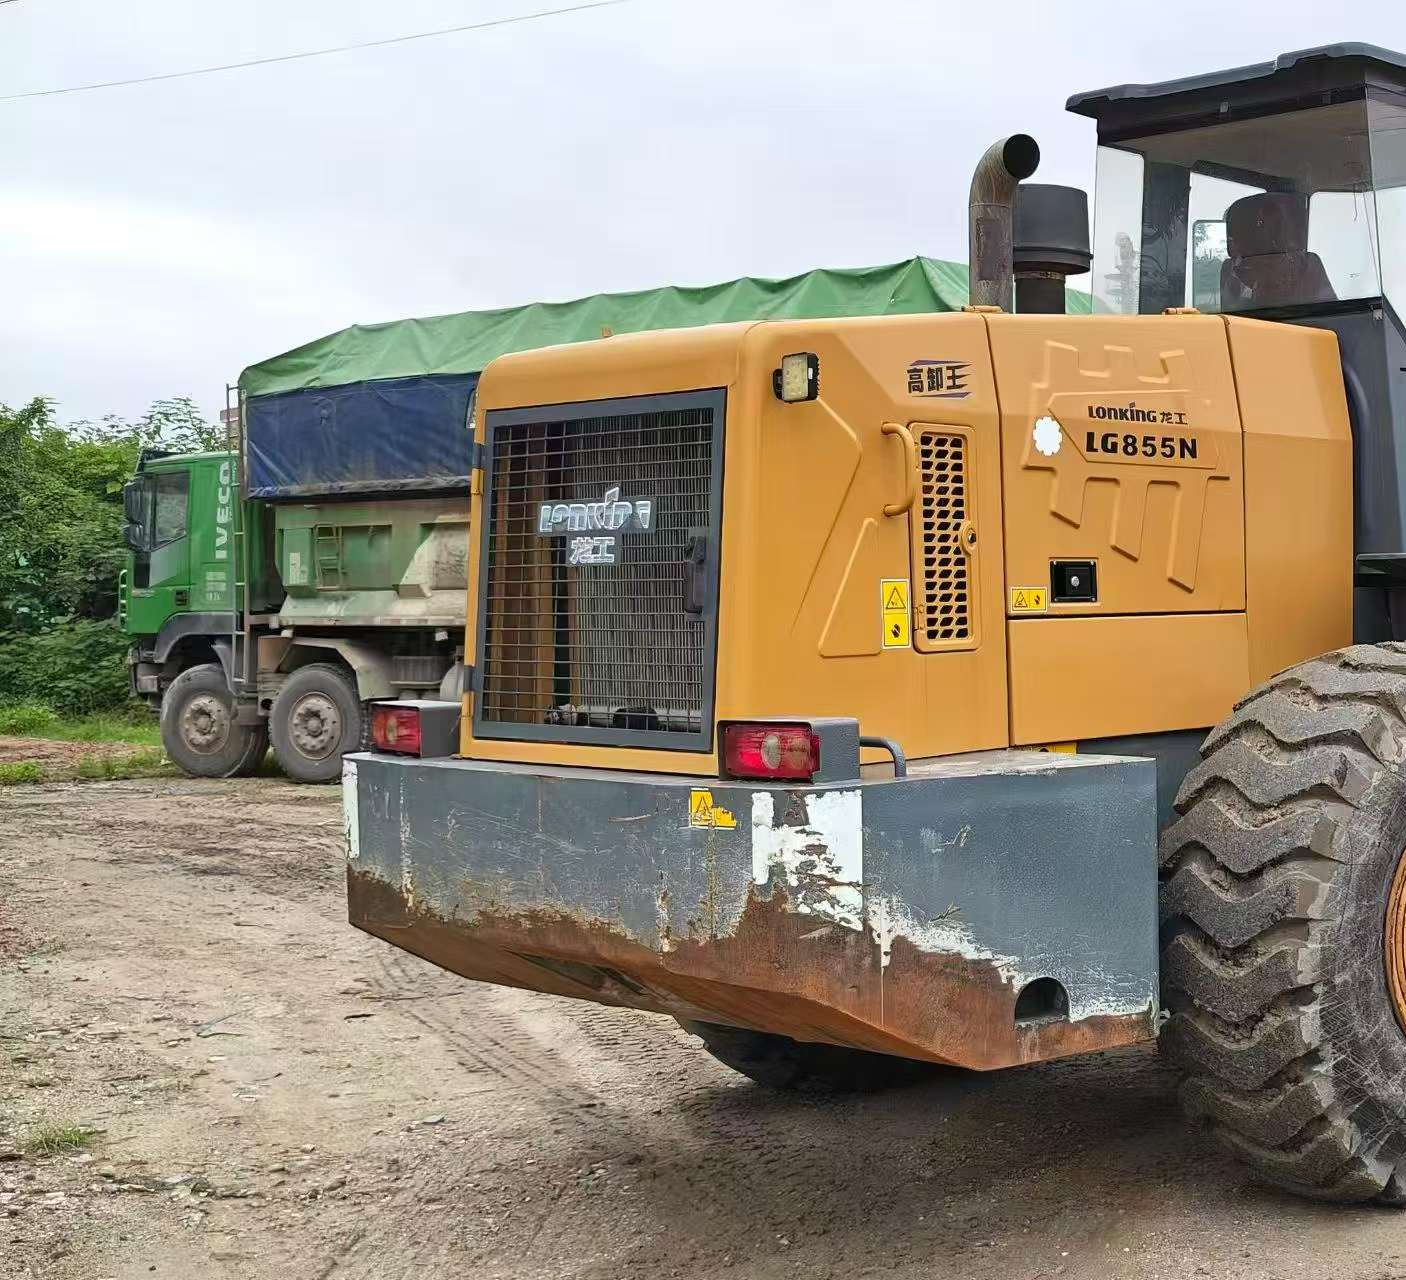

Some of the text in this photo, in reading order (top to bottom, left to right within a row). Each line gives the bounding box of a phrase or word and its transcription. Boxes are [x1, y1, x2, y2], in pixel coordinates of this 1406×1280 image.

[907, 365, 972, 393] 高卸王
[1160, 411, 1188, 425] 龙工
[1086, 431, 1198, 459] LG855N
[215, 461, 231, 559] IVECO
[570, 537, 616, 564] 龙工
